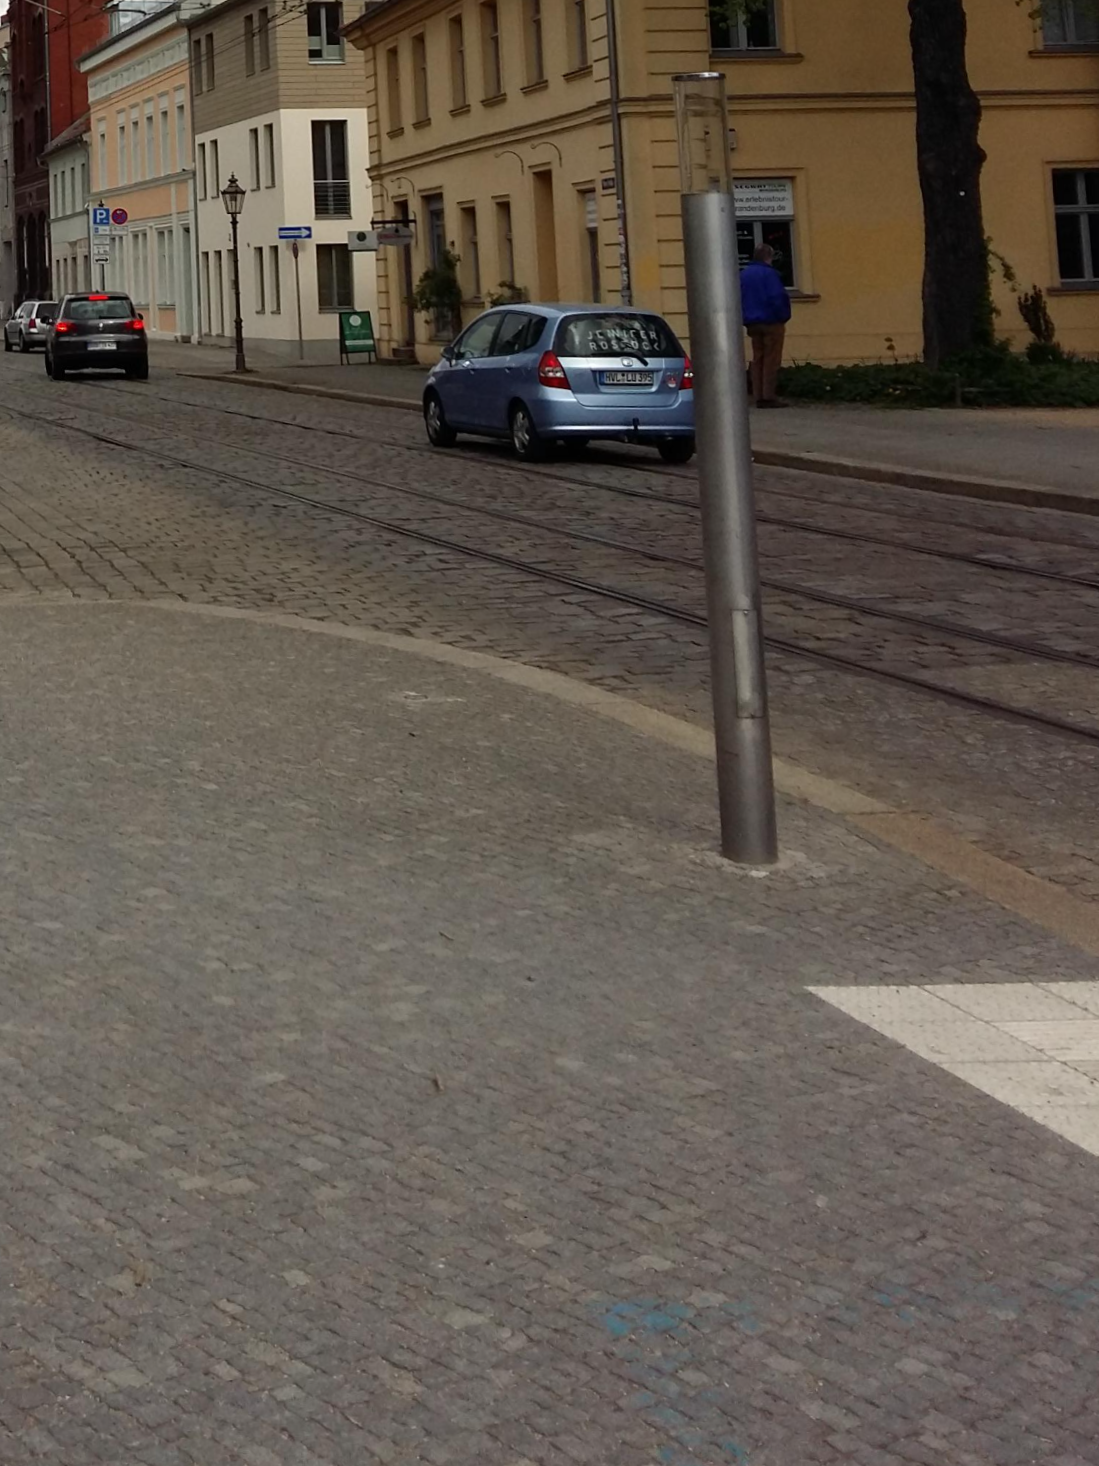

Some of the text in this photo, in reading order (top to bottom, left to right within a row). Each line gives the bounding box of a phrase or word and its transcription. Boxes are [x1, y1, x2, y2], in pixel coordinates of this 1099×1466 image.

[735, 205, 786, 213] randenburg.de
[96, 210, 106, 223] P
[589, 340, 660, 351] ROSOCK
[638, 373, 652, 382] 395
